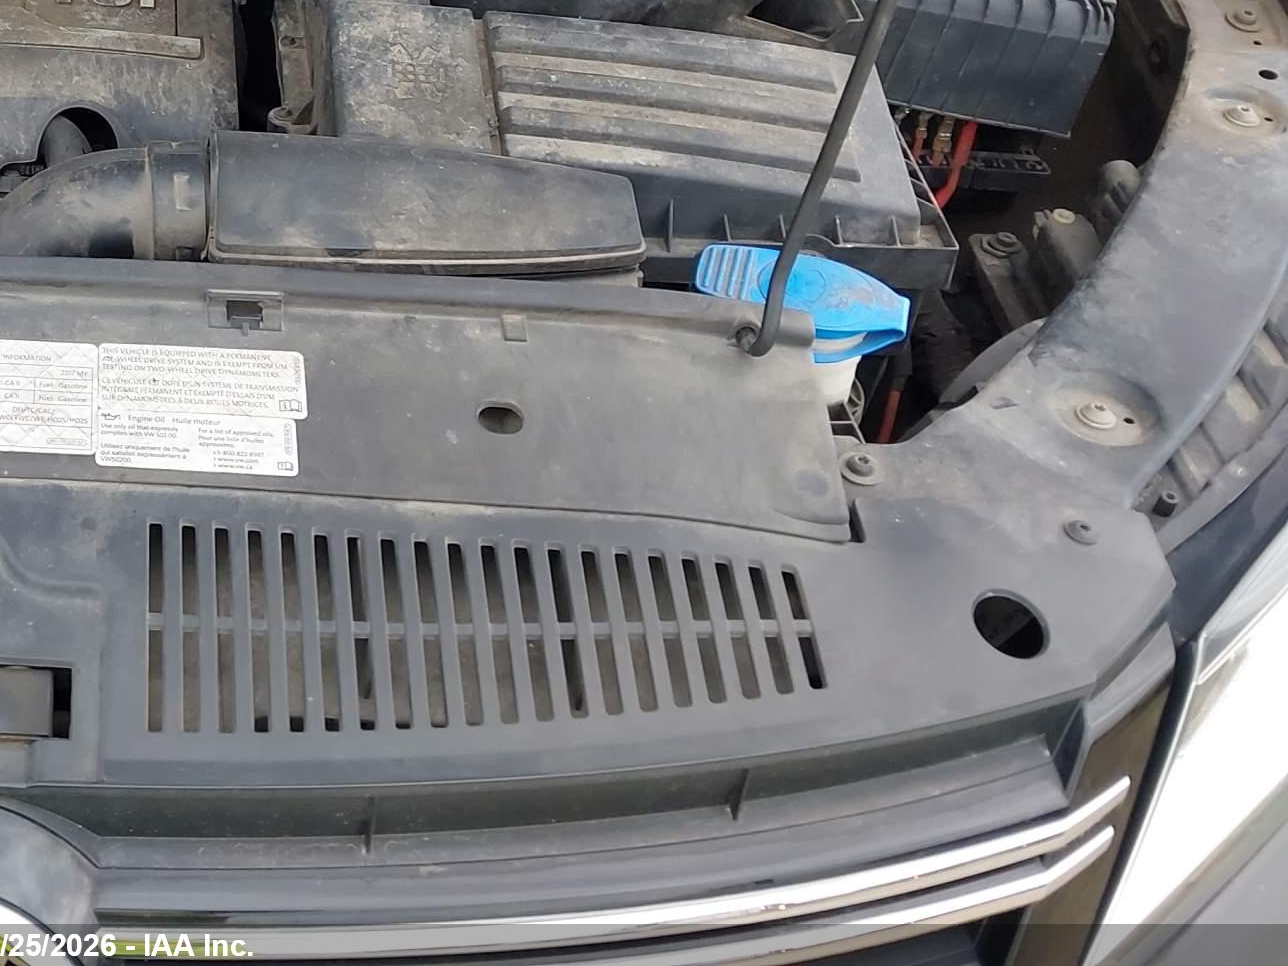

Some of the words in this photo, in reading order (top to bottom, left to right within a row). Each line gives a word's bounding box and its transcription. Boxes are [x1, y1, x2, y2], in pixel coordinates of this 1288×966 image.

[160, 350, 197, 358] EQUIPPED
[198, 351, 218, 359] WITH
[167, 358, 195, 366] SYSTEM
[196, 359, 214, 367] AND
[222, 360, 251, 368] EXEMPT
[244, 384, 299, 393] TRANSMISSION
[127, 415, 153, 424] Engine
[172, 417, 191, 425] Huile
[192, 419, 221, 427] moteur
